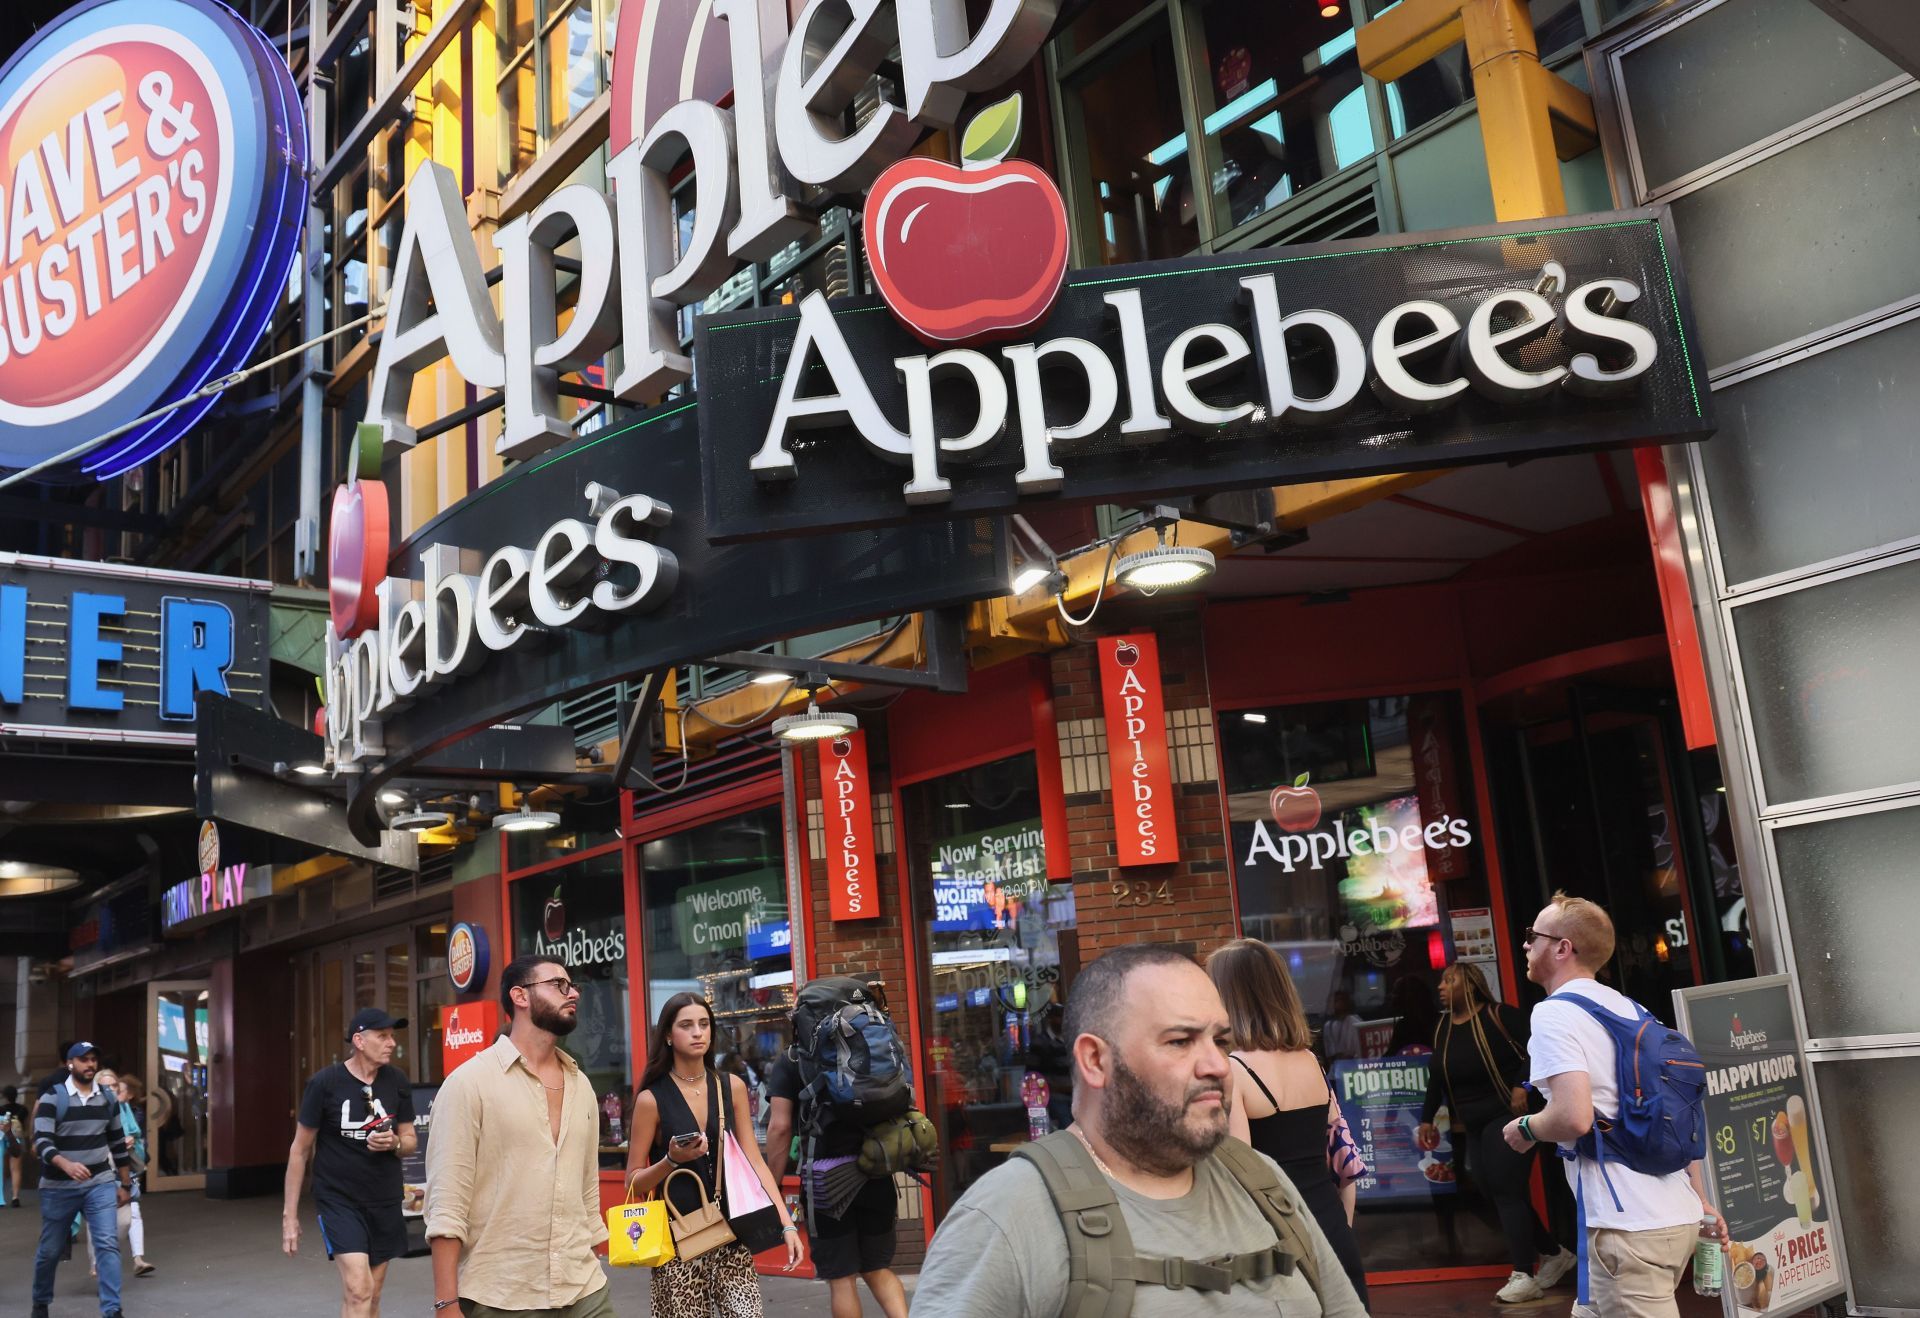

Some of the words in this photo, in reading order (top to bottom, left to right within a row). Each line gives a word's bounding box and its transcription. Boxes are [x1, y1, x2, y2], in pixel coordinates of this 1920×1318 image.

[0, 90, 141, 265] AVE
[138, 70, 200, 157] &
[749, 261, 1658, 505] Applebee's
[1120, 668, 1157, 857] Applebee's
[834, 758, 862, 913] Applebee's
[1245, 814, 1472, 873] Applebee's
[940, 844, 977, 867] Now
[954, 850, 1041, 890] Breakfast
[201, 862, 247, 914] PLAY
[1112, 879, 1176, 908] 234
[693, 921, 742, 945] C'mon
[445, 1027, 484, 1050] Applebee's
[1358, 1062, 1384, 1070] HAPPY
[1385, 1060, 1407, 1068] HOUR
[1705, 1061, 1758, 1096] HAPPY
[1759, 1054, 1797, 1084] HOUR
[1343, 1069, 1430, 1100] FOOTBAL
[340, 1098, 392, 1130] LA
[1752, 1116, 1767, 1145] $7
[340, 1130, 367, 1140] GE
[1715, 1125, 1736, 1154] $8
[1787, 1227, 1828, 1264] PRICE
[1778, 1253, 1831, 1289] APPETIZERS
